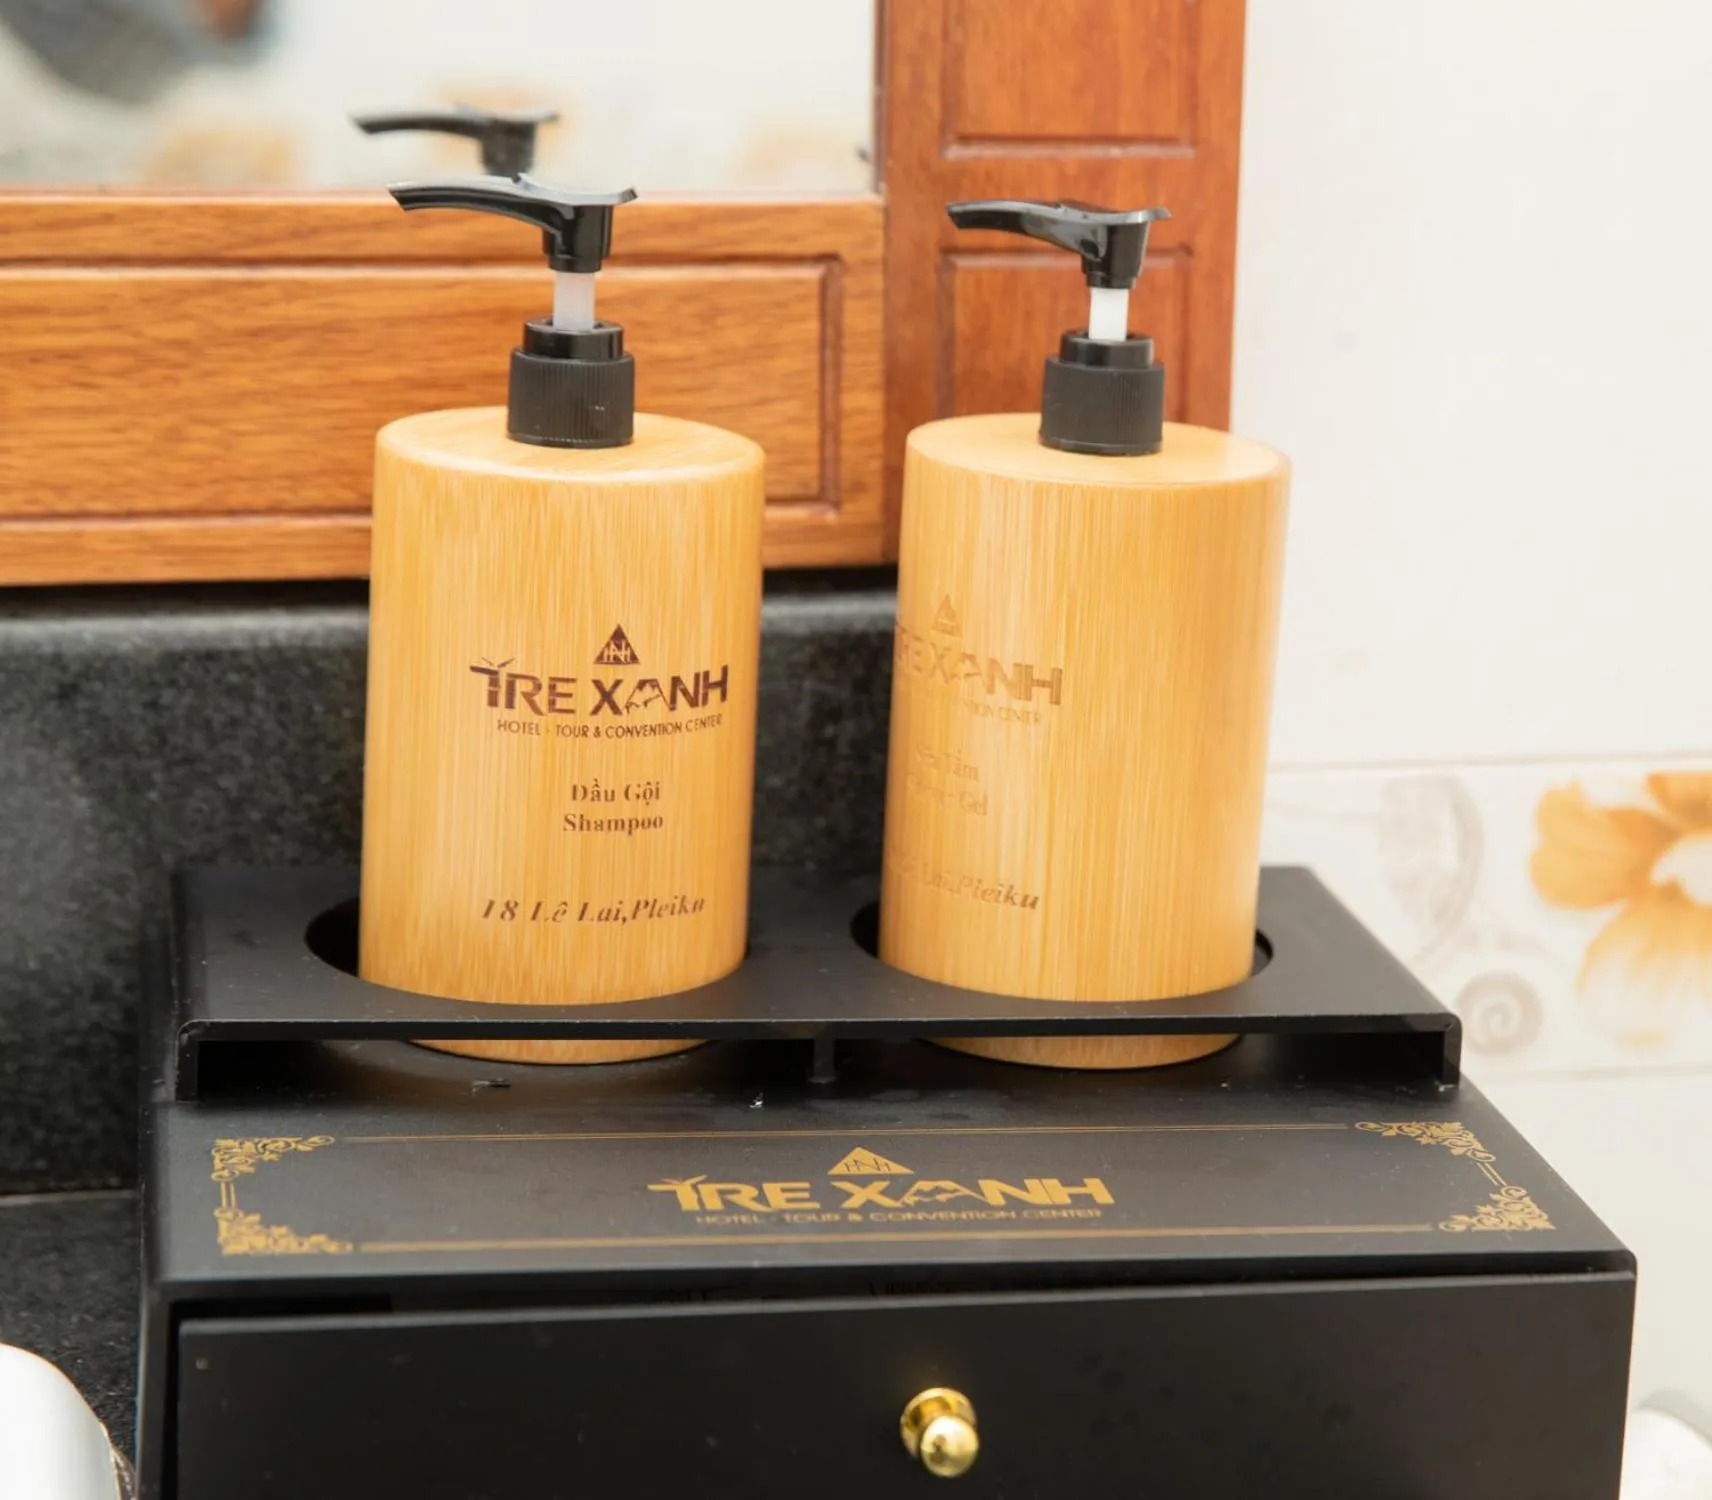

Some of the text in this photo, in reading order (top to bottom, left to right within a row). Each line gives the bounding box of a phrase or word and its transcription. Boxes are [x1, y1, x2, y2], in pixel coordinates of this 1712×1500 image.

[469, 656, 729, 717] TRE XANH
[496, 713, 723, 740] HOTEL TOUR & CONVENTION CENTER
[571, 778, 662, 806] Dầu Gội
[563, 813, 664, 836] Shampoo
[482, 899, 519, 923] 18
[530, 900, 569, 923] Lê
[647, 1174, 1115, 1213] TRE XANH
[696, 1213, 760, 1225] HOTEL
[782, 1212, 840, 1224] TOUR
[869, 1210, 1017, 1223] CONVENTION
[1023, 1208, 1102, 1219] CENTER
